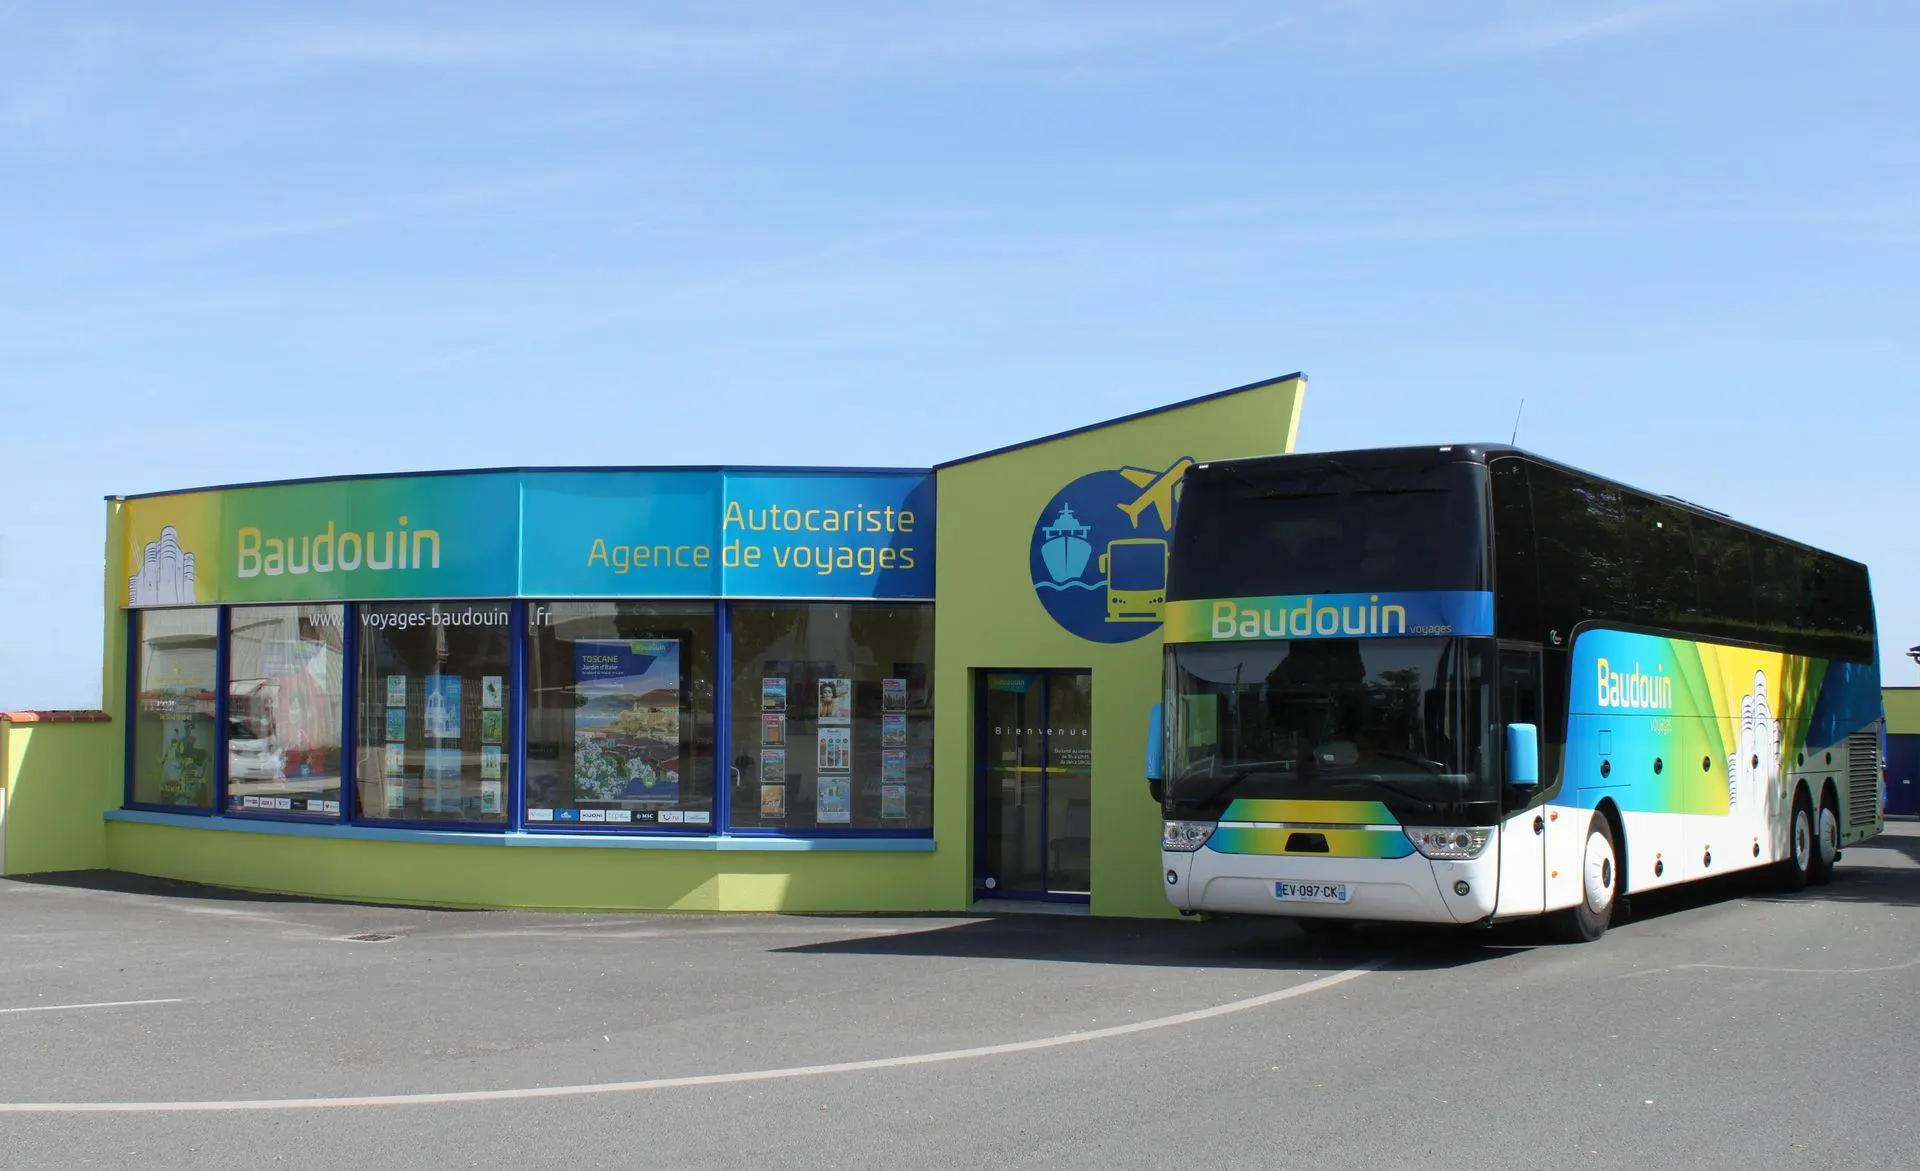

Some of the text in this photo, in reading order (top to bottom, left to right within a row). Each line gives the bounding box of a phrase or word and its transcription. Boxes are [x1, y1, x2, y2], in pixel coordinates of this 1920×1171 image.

[722, 501, 915, 532] Autocariste
[237, 515, 441, 578] Baudouin
[587, 538, 915, 576] Agence de voyages
[361, 607, 509, 630] voyages-baudouin
[1211, 594, 1452, 638] Baudouin voyages
[582, 655, 619, 663] TOSCANE
[1597, 657, 1672, 709] Baudouin
[995, 726, 1088, 736] Bienvenue
